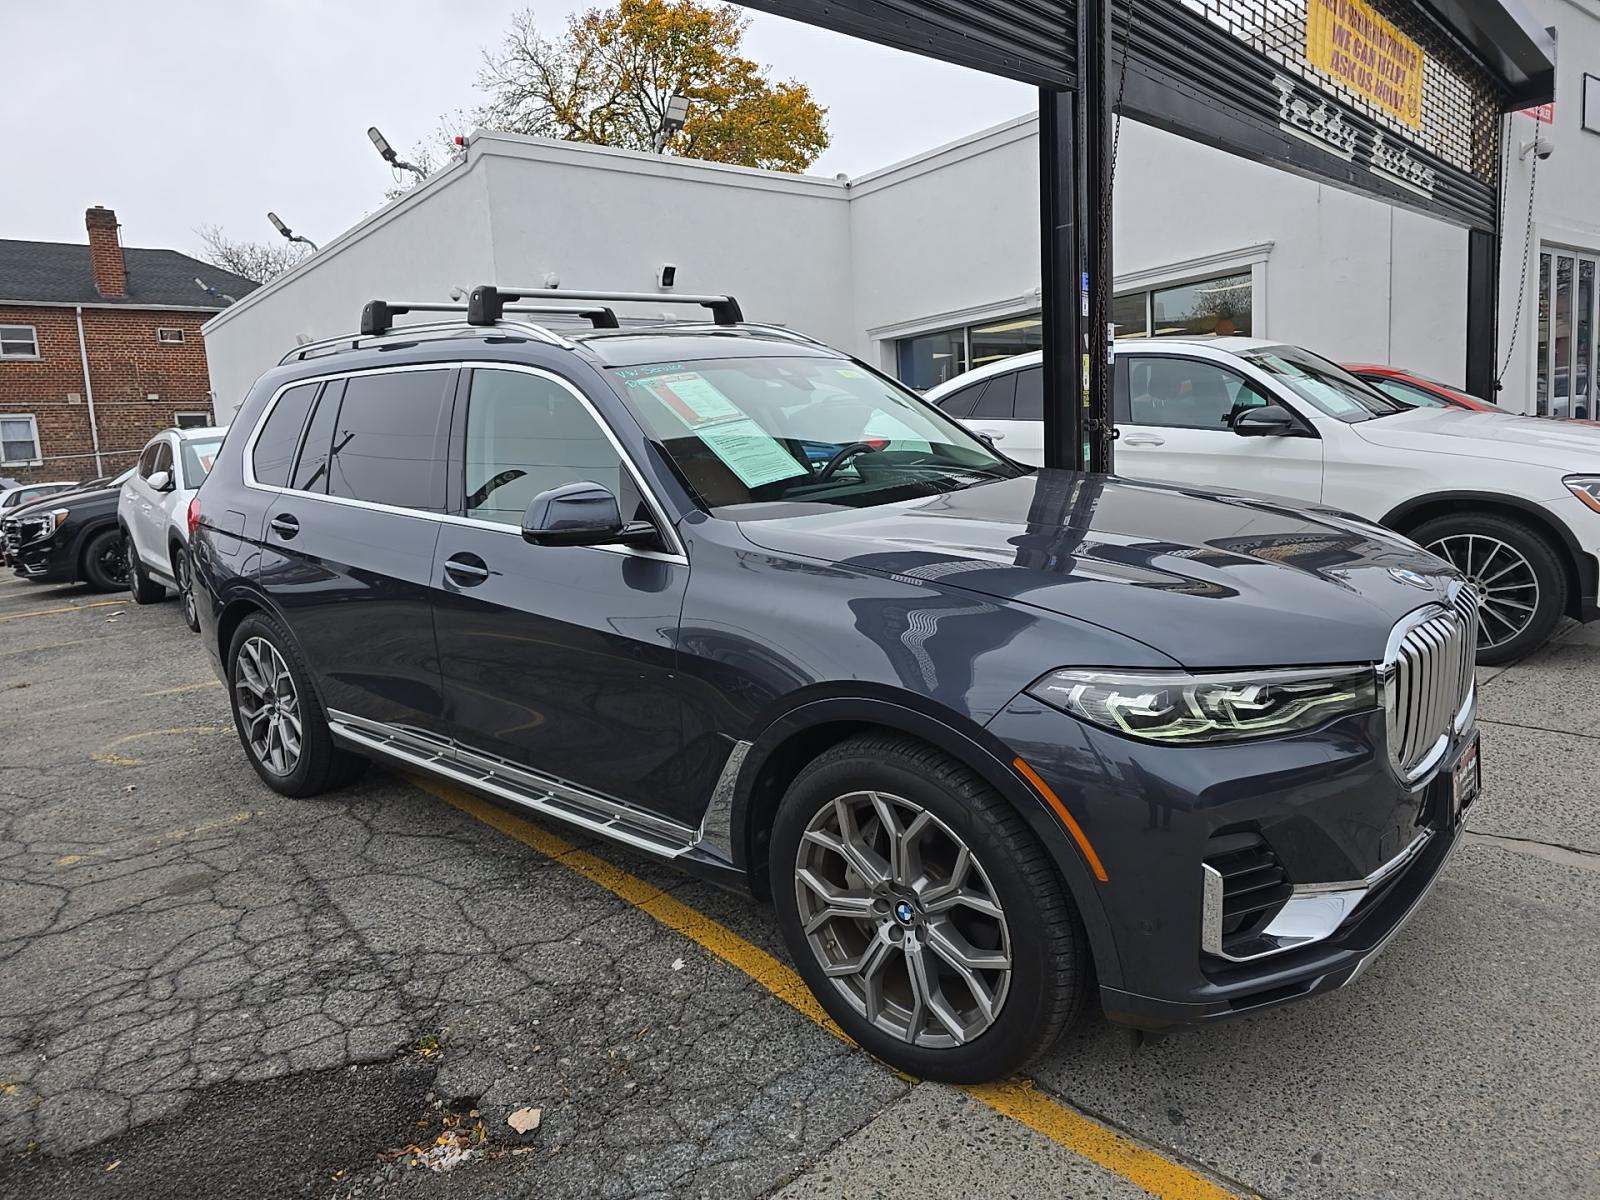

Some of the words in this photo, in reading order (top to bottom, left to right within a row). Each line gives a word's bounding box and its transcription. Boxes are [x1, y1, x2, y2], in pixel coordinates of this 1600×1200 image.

[1330, 49, 1357, 83] ASK
[1357, 67, 1373, 93] US
[1375, 78, 1405, 112] NOW!
[1333, 24, 1352, 51] WE
[1352, 37, 1376, 69] CAN
[1378, 55, 1406, 88] HELP!
